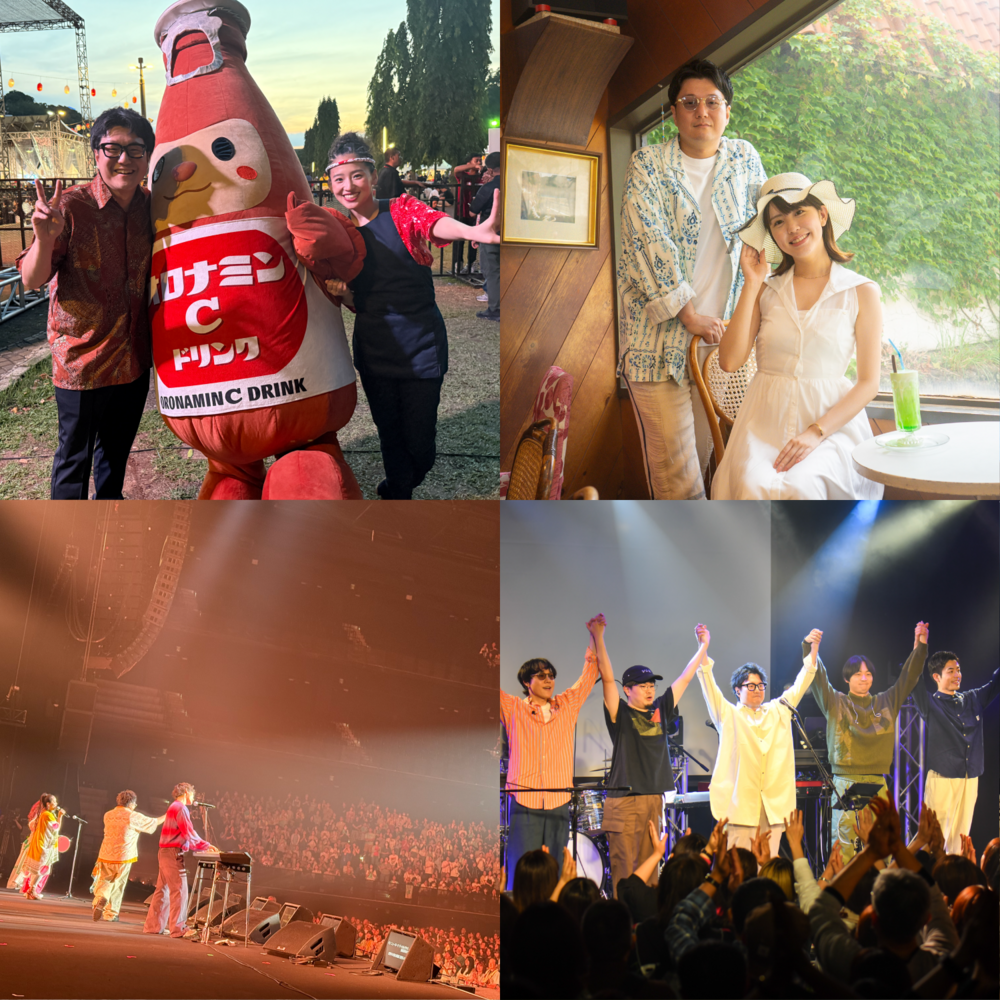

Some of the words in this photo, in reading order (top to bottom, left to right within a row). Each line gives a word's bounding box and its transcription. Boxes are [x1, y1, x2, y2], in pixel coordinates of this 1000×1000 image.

[185, 297, 222, 334] C
[172, 336, 260, 371] ドリンク
[247, 377, 307, 401] DRINK
